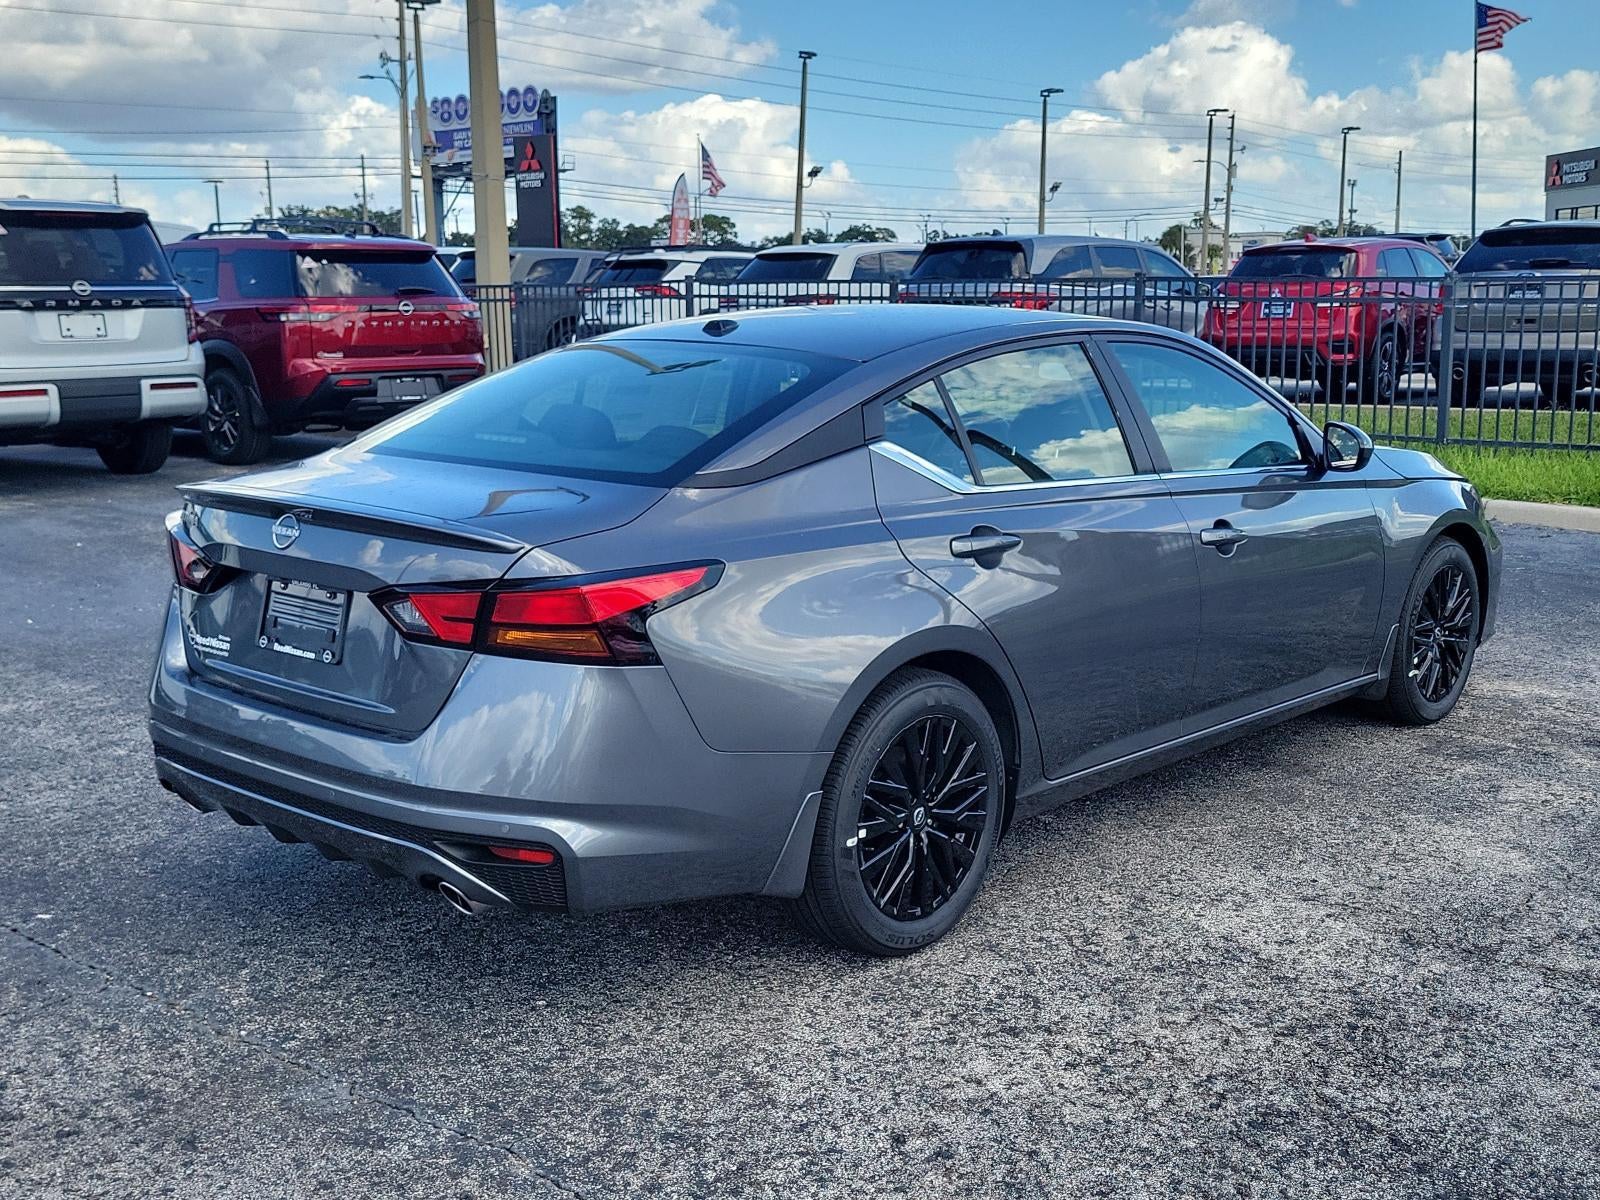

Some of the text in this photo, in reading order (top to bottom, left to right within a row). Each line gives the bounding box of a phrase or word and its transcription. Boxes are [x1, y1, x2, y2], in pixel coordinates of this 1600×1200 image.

[1562, 160, 1595, 174] MITSUBISHI
[1562, 171, 1587, 185] MOTORS
[22, 299, 142, 308] ARMADA
[344, 319, 462, 328] PATHFINDER
[272, 524, 301, 538] NISSAN
[885, 928, 936, 946] SOLUS
